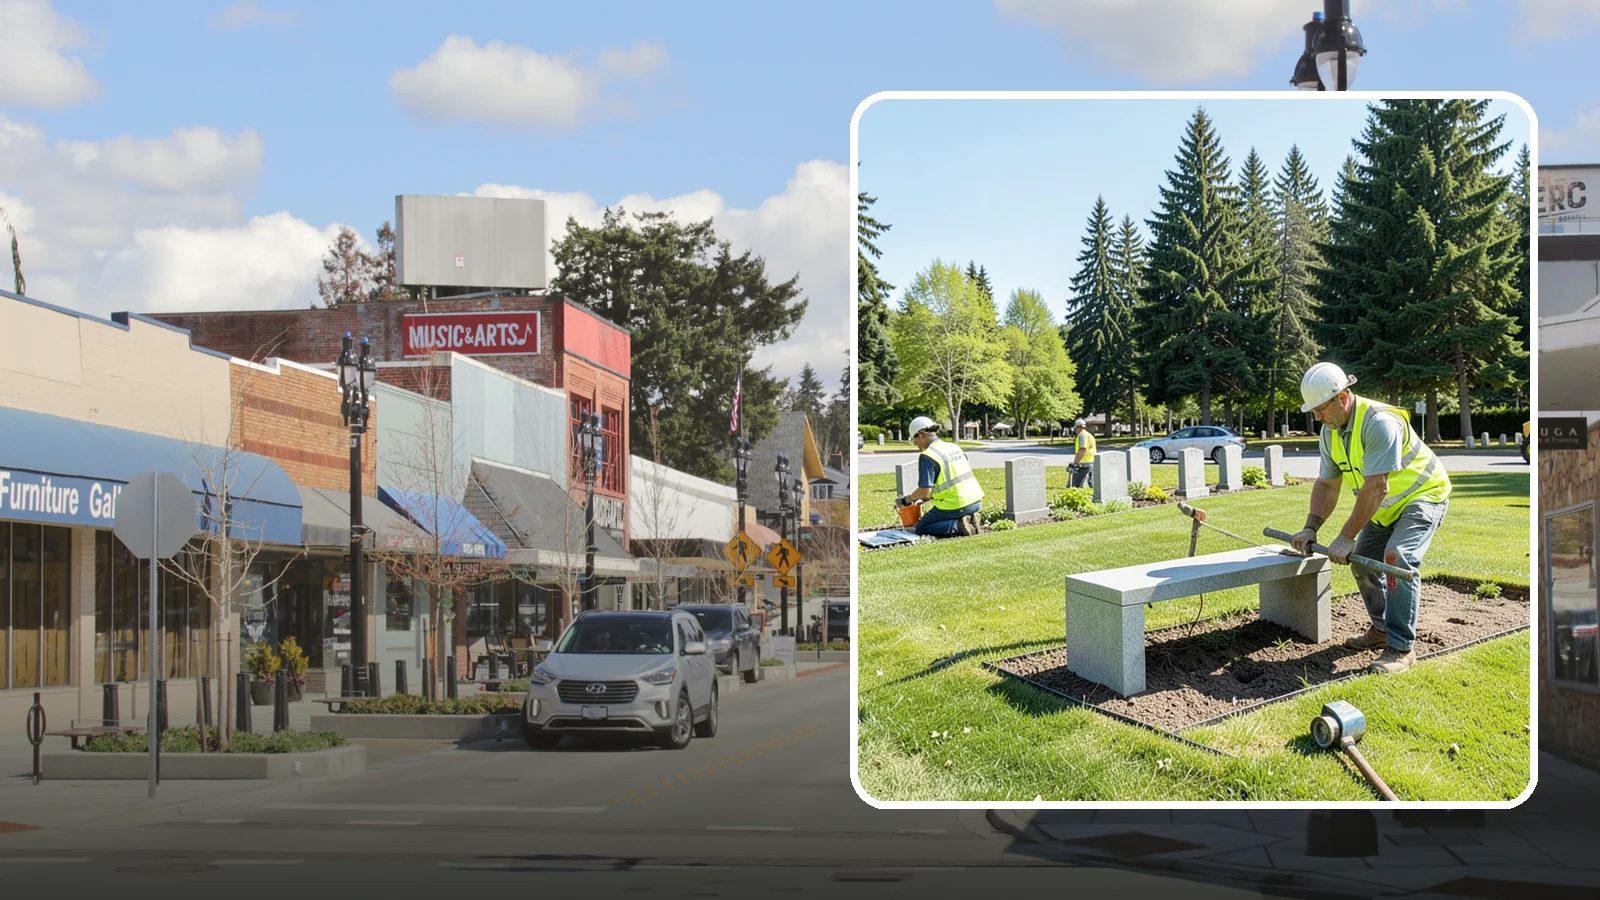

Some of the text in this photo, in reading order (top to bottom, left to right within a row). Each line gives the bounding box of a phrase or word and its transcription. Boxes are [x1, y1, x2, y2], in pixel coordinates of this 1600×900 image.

[408, 322, 520, 349] MUSIC&ARTS
[1540, 427, 1578, 437] UGA
[0, 471, 122, 519] Furniture Gal
[453, 562, 480, 574] SUSHI
